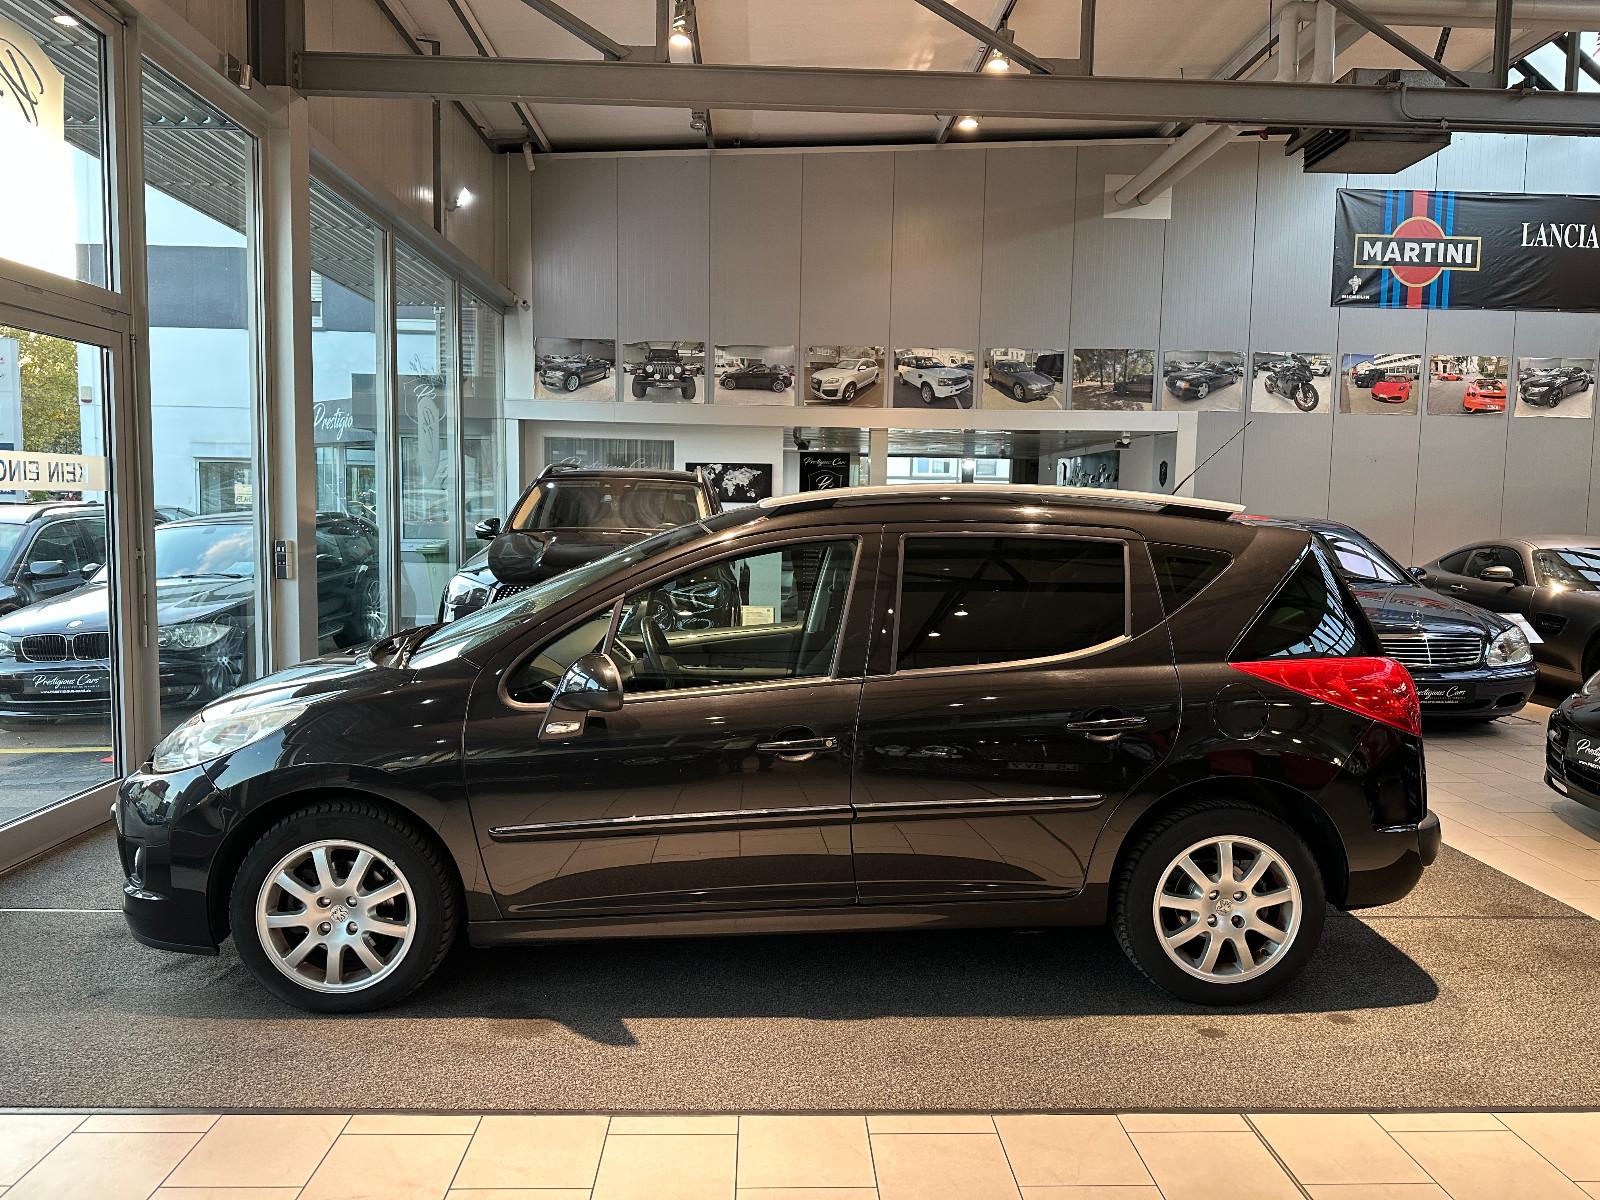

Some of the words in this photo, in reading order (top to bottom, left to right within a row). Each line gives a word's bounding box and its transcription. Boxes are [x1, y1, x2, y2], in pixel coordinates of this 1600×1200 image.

[1520, 222, 1600, 249] LANCIA
[1362, 240, 1473, 264] MARTINI
[32, 674, 75, 689] Prestigious
[76, 673, 100, 686] Cars
[1415, 686, 1446, 700] restigious
[1446, 685, 1467, 698] Cars
